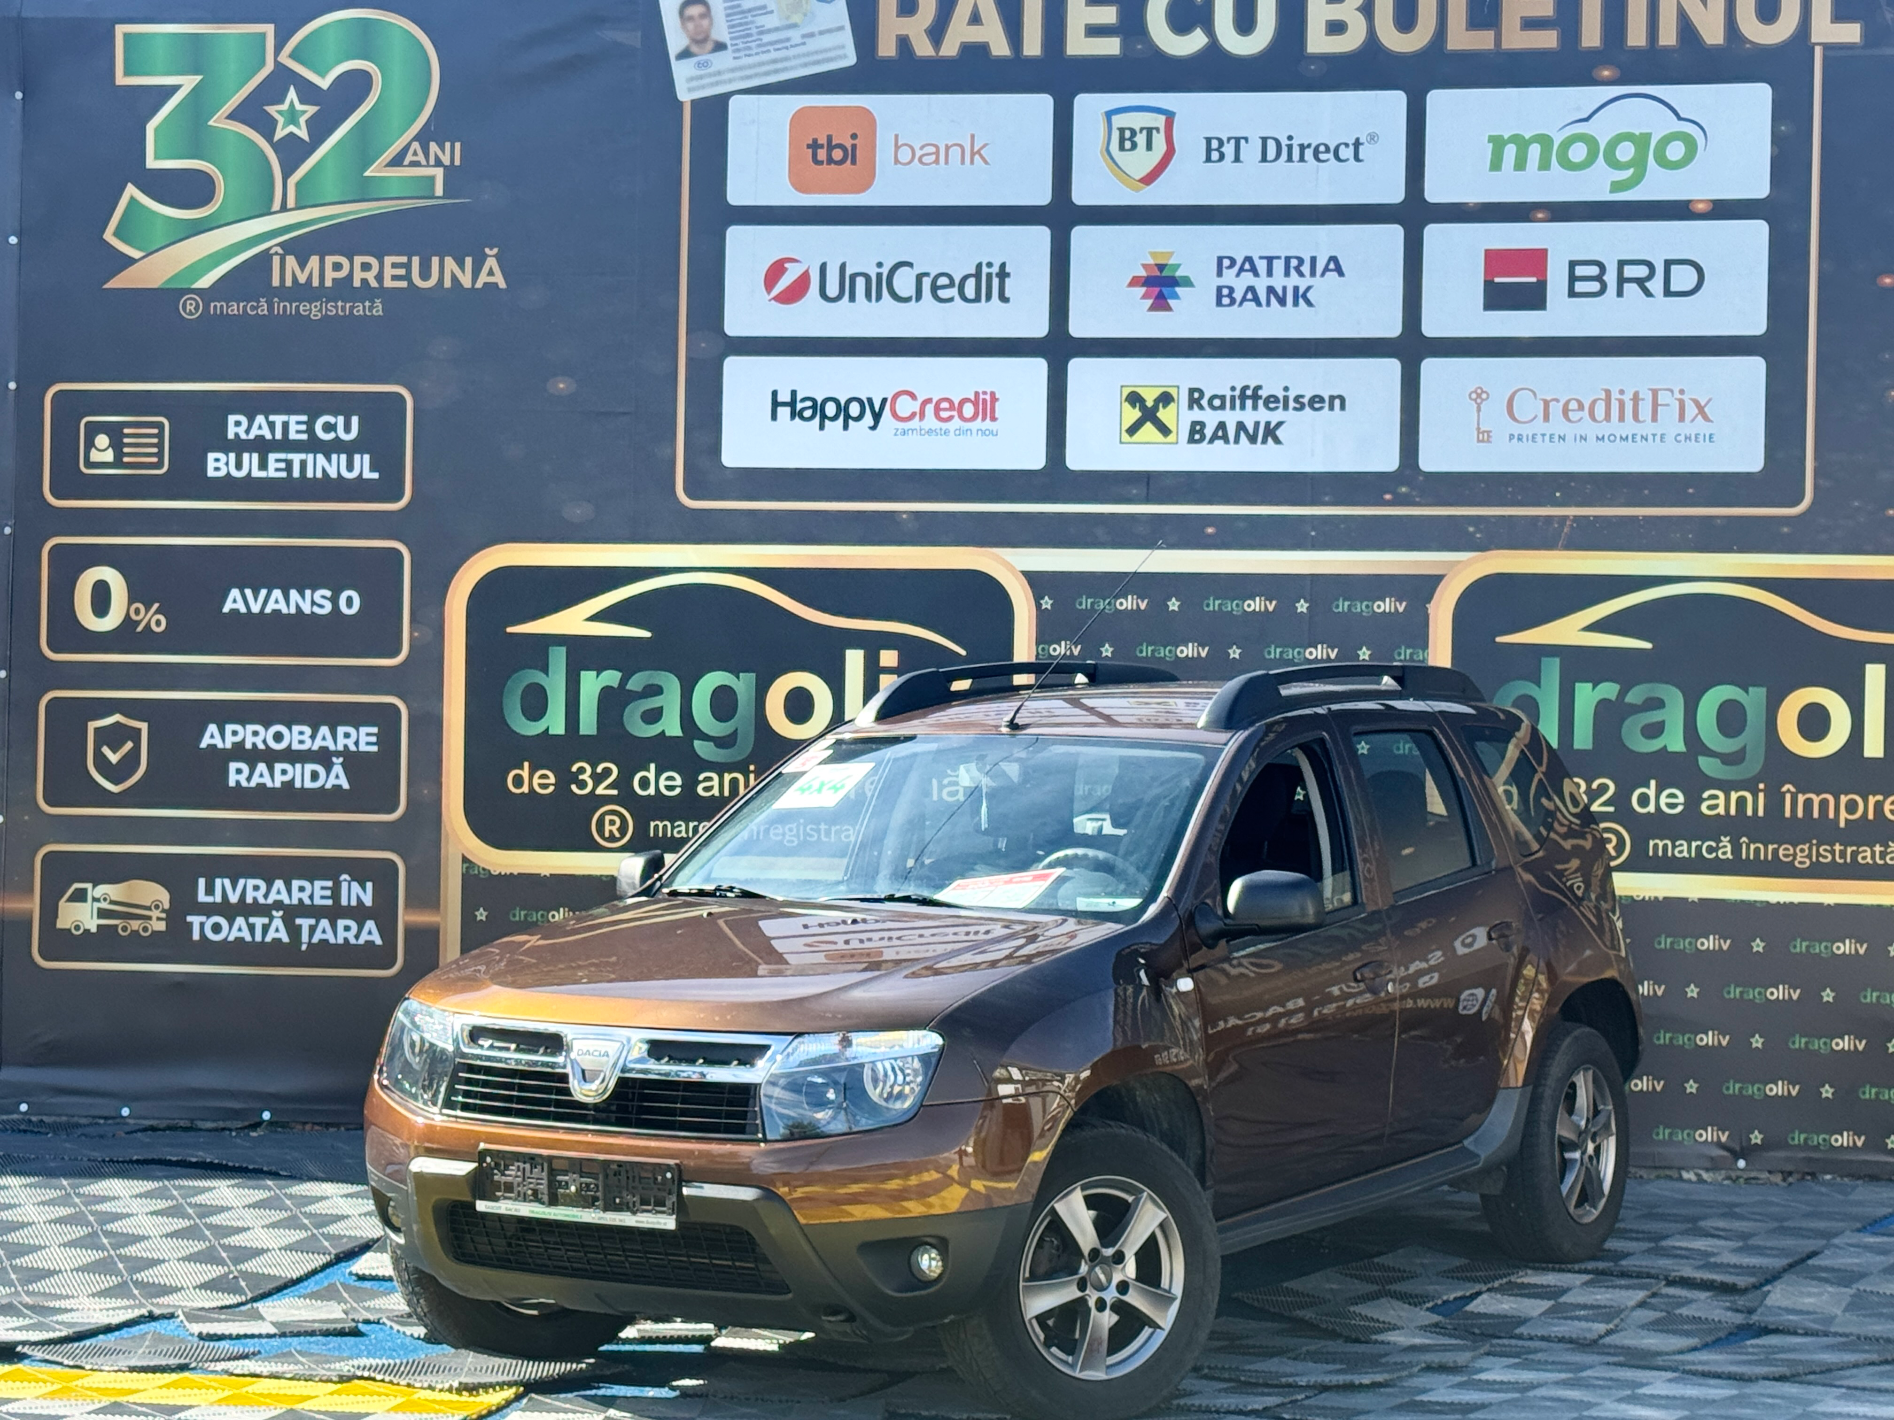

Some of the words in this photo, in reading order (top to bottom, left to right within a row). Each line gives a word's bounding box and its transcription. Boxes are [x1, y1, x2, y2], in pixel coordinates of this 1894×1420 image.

[103, 8, 444, 259] 32
[1117, 126, 1161, 153] BT
[403, 141, 461, 167] ANI
[806, 132, 859, 167] tbi
[892, 133, 991, 167] bank
[1203, 136, 1249, 164] BT
[1487, 130, 1699, 194] mogo
[270, 246, 508, 290] ÎMPREUNĂ
[1215, 255, 1346, 279] PATRIA
[1567, 259, 1706, 299] BRD
[818, 260, 1011, 304] UniCredit
[210, 298, 269, 317] marcă
[274, 297, 384, 319] înregistrată
[1214, 284, 1316, 308] BANK
[771, 389, 1000, 431] HappyCredit
[1187, 385, 1347, 413] Raiffeisen
[1505, 387, 1714, 425] CreditFix
[226, 414, 307, 440] RATE
[315, 414, 360, 440] CU
[893, 425, 950, 438] zambeste
[953, 425, 973, 437] din
[976, 427, 999, 437] nou
[1186, 421, 1286, 446] BANK
[1508, 433, 1567, 444] PRIETEN
[1573, 433, 1588, 444] IN
[1595, 433, 1669, 444] MOMENTE
[1674, 433, 1716, 444] CHEIE
[206, 453, 379, 480] BULETINUL
[222, 588, 333, 615] AVANS
[338, 589, 361, 615] 0
[1075, 595, 1149, 613] dragoliv
[1203, 596, 1277, 615] dragoliv
[1332, 597, 1407, 616] dragoliv
[1036, 640, 1082, 661] goliv
[1135, 642, 1210, 661] dragoliv
[1264, 643, 1339, 663] dragoliv
[200, 724, 379, 752] APROBARE
[228, 757, 350, 790] RAPIDĂ
[506, 761, 556, 796] de
[570, 761, 619, 796] 32
[633, 763, 682, 797] de
[1631, 779, 1685, 815] de
[1700, 782, 1766, 818] ani
[1648, 835, 1733, 860] marcă
[198, 877, 333, 906] LIVRARE
[340, 874, 374, 908] ÎN
[186, 911, 290, 943] TOATĂ
[296, 916, 383, 951] ȚARA
[1654, 934, 1731, 953] dragoliv
[1789, 937, 1868, 957] dragoliv
[1723, 984, 1800, 1003] dragoliv
[576, 1048, 610, 1059] DACIA
[1653, 1030, 1730, 1049] dragoliv
[1788, 1034, 1867, 1053] dragoliv
[1722, 1079, 1800, 1099] dragoliv
[1652, 1125, 1729, 1145] dragoliv
[1787, 1129, 1866, 1150] dragoliv
